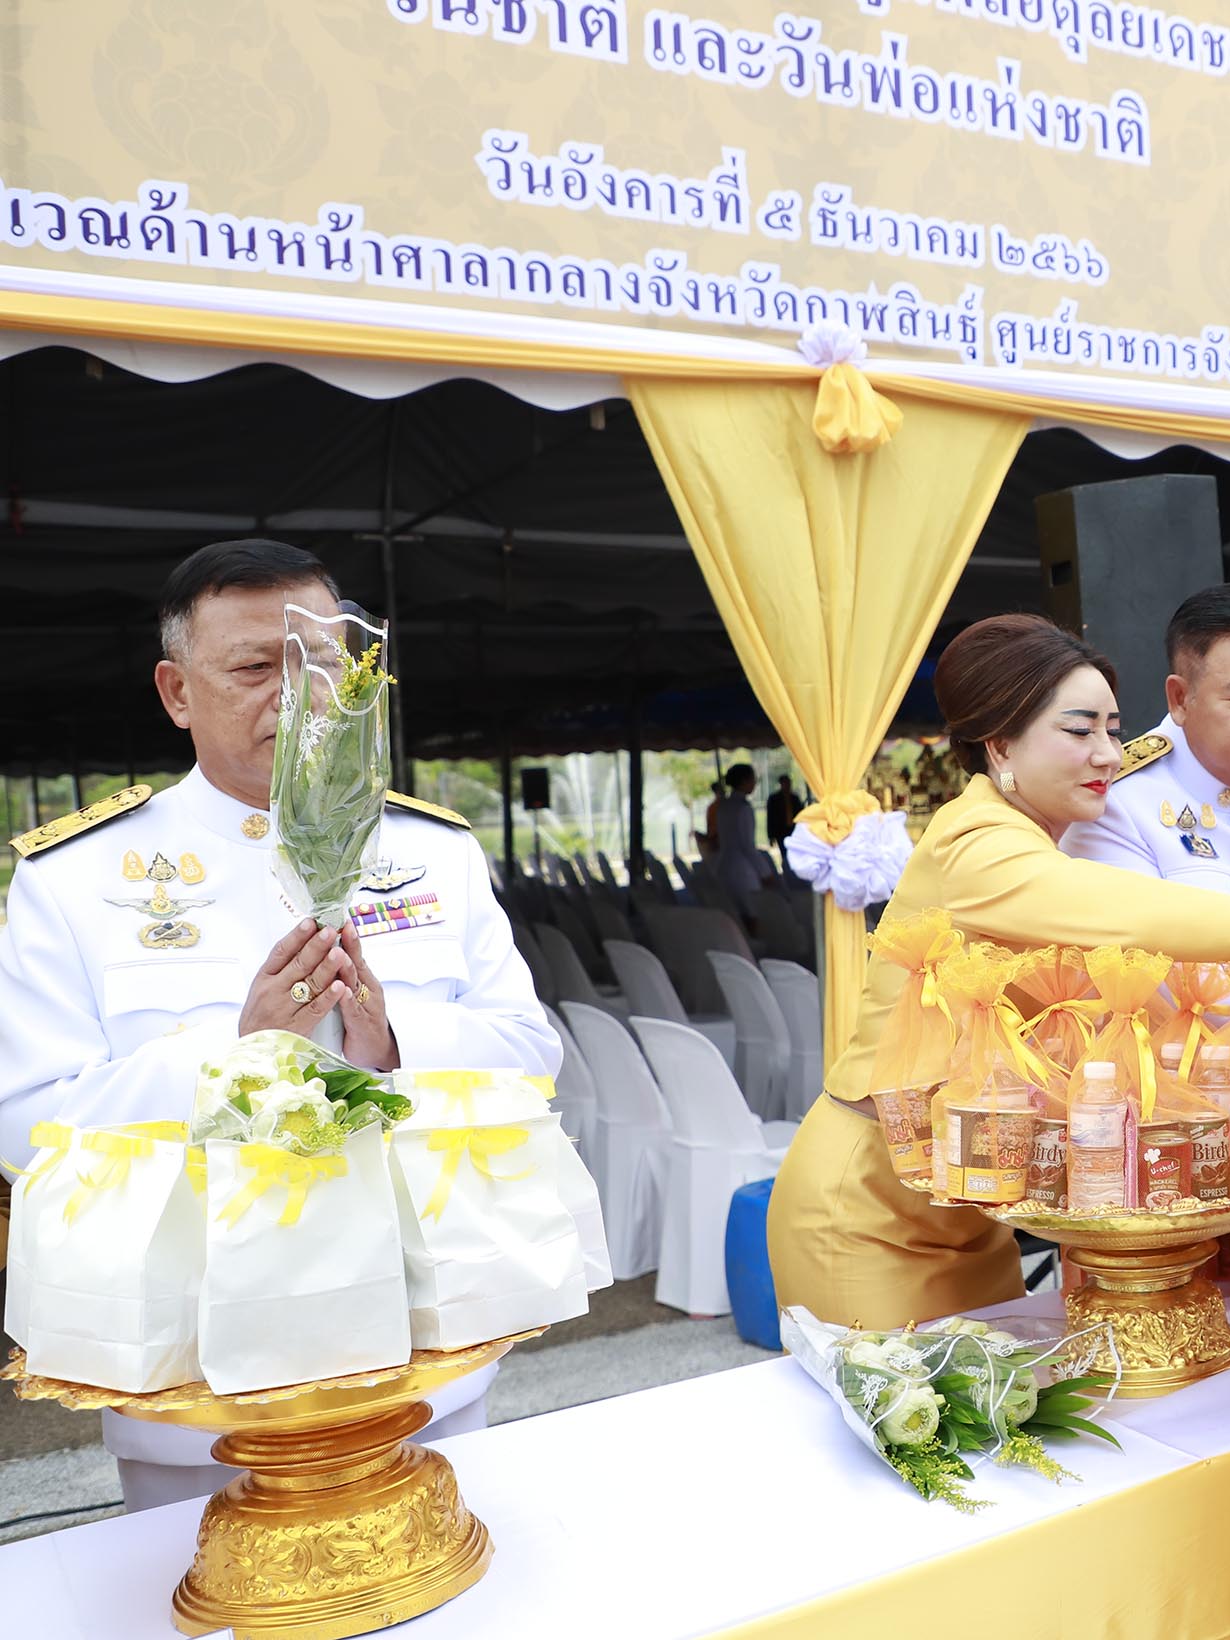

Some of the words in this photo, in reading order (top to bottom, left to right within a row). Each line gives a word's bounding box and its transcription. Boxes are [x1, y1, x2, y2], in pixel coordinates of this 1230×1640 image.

[652, 17, 1146, 158] และวันพ่อแห่งชาติ
[485, 136, 744, 226] วันอังคารที่
[763, 197, 796, 233] ๕
[816, 189, 980, 261] ธันวาคม
[996, 232, 1106, 279] ๒๕๖๖
